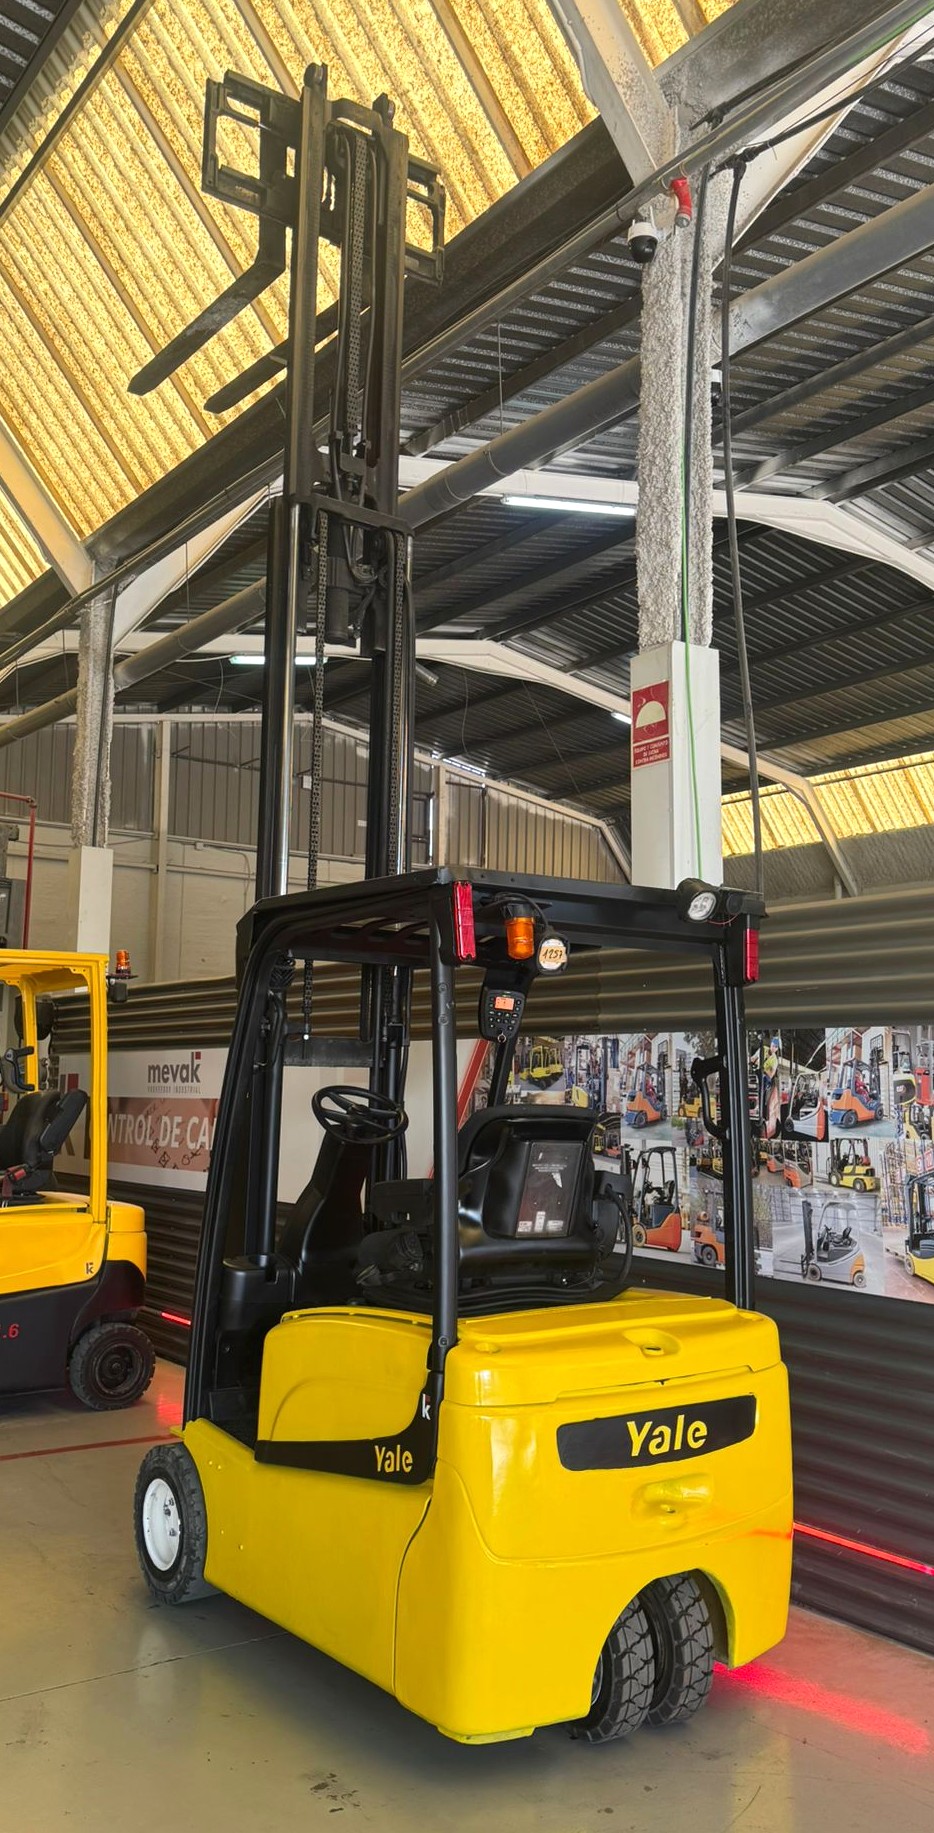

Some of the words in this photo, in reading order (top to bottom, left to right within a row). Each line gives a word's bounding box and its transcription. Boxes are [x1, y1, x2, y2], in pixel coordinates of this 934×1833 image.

[542, 948, 563, 960] 1257
[147, 1051, 202, 1084] mevak
[91, 1113, 154, 1147] NTROL
[158, 1115, 183, 1149] DE
[626, 1414, 708, 1457] Yale
[374, 1444, 413, 1473] Yale
